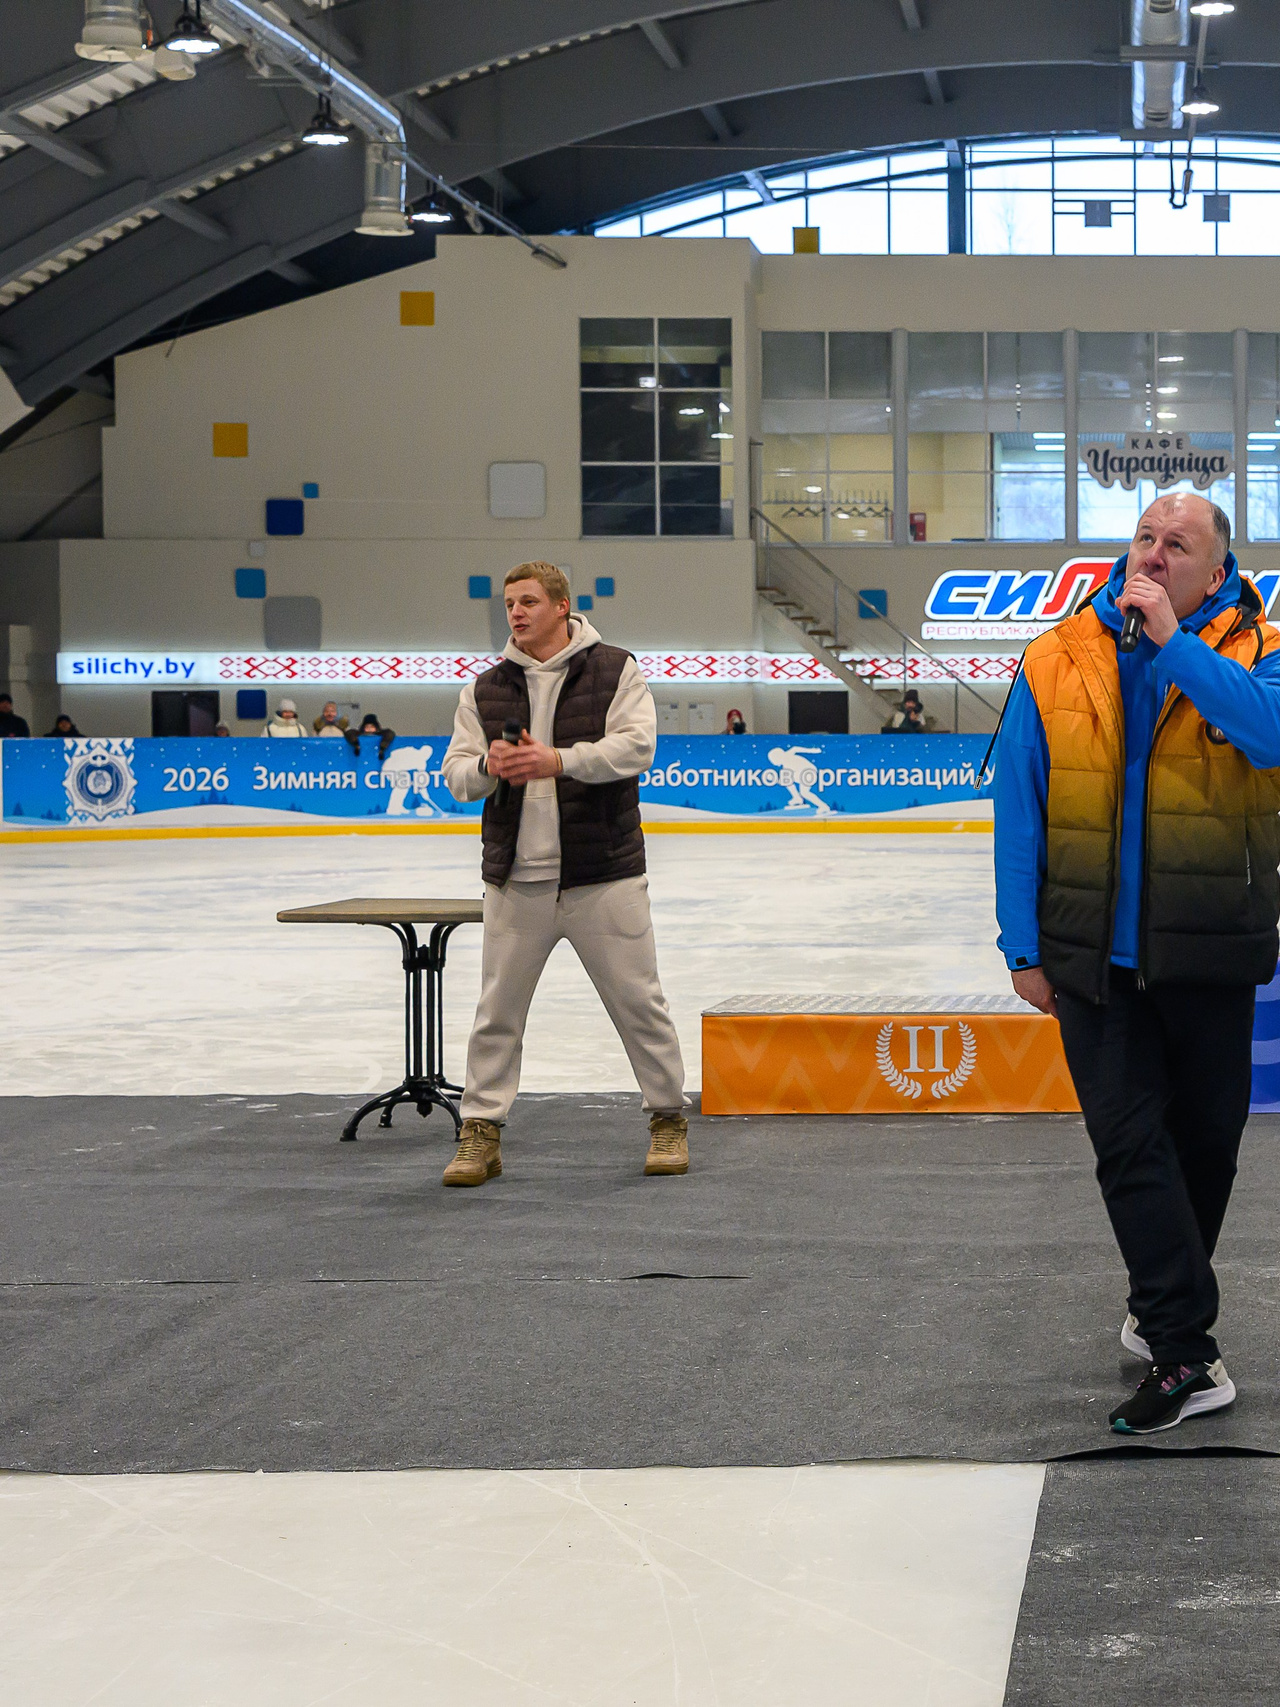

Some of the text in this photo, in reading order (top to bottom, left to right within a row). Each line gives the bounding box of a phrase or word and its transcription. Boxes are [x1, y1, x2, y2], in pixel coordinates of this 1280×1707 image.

[1131, 438, 1184, 450] КАФЕ
[926, 626, 1051, 636] РЕСПУБЛИКАН
[72, 657, 195, 678] silichy.by
[163, 767, 230, 792] 2026
[252, 765, 357, 791] Зимняя
[364, 770, 449, 794] спарт
[800, 762, 975, 792] организаций
[901, 1025, 950, 1073] II
